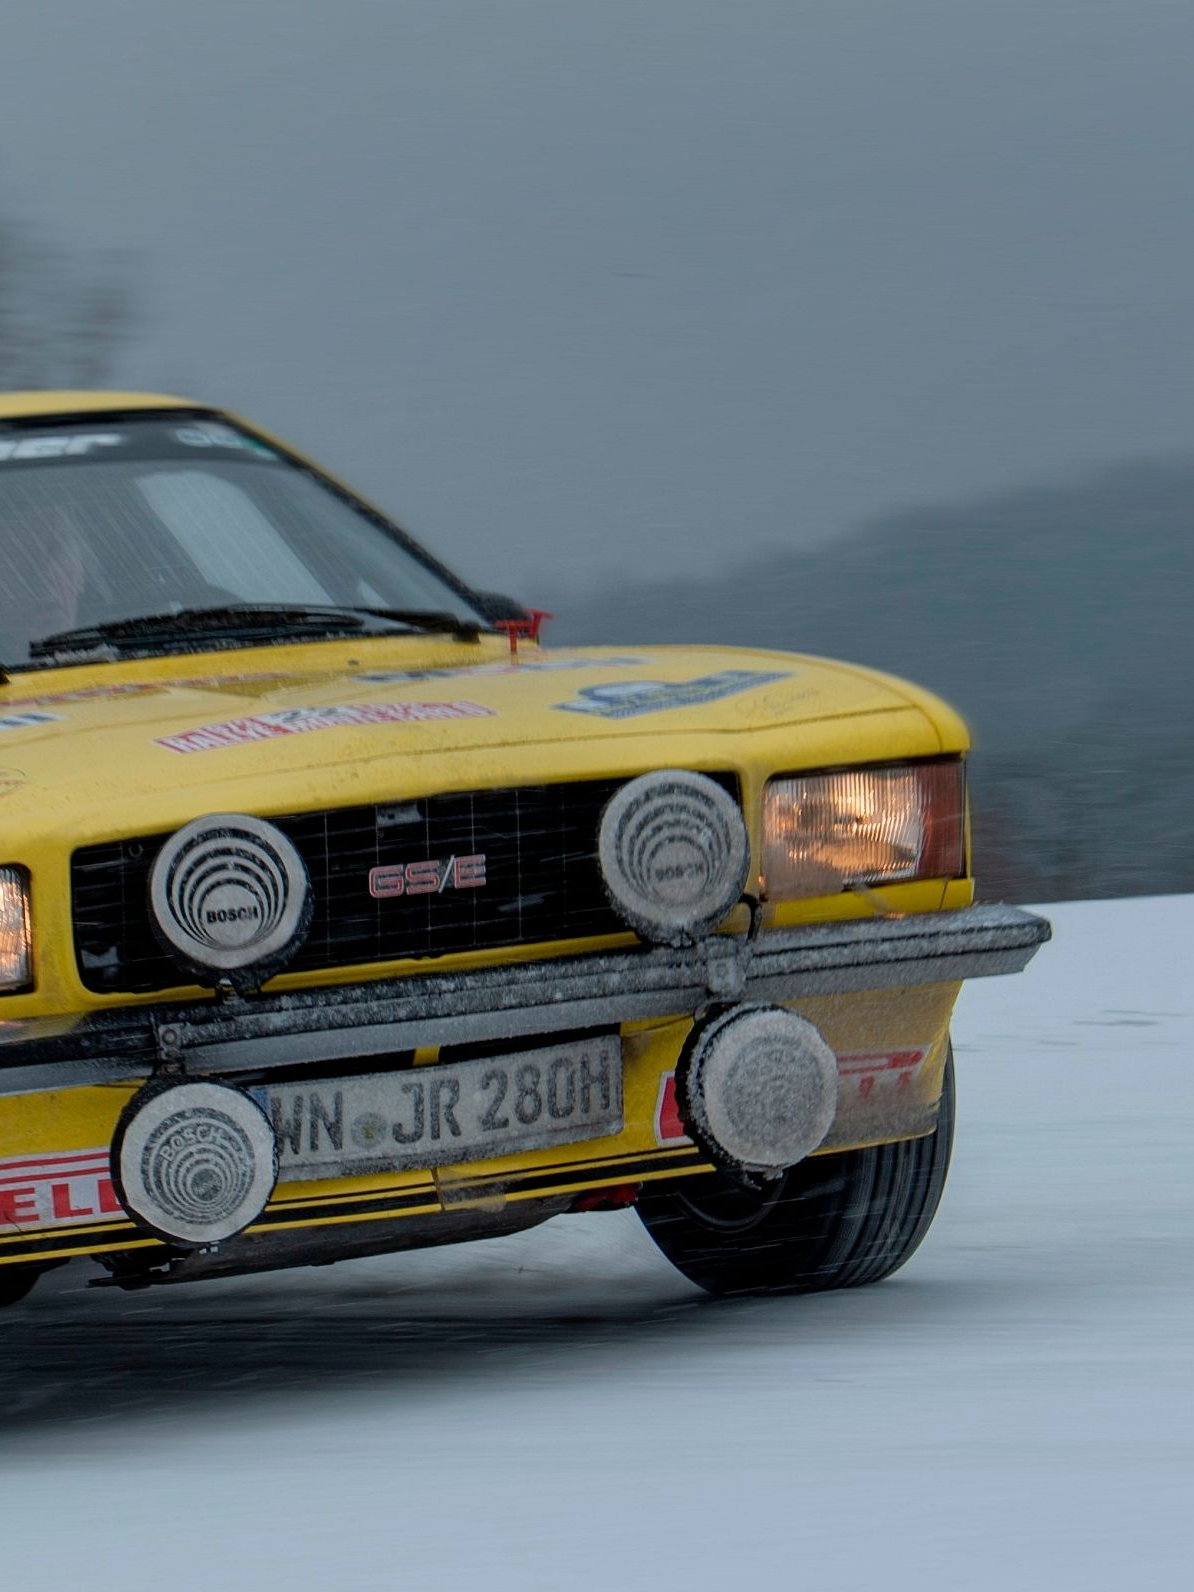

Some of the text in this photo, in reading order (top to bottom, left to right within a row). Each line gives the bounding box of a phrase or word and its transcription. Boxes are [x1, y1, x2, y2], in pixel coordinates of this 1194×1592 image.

[369, 853, 487, 899] GS/E
[206, 905, 259, 926] BOSCH
[270, 1089, 344, 1156] WN
[392, 1076, 462, 1144] JR
[477, 1051, 611, 1135] 280H
[159, 1125, 224, 1162] BOSCH
